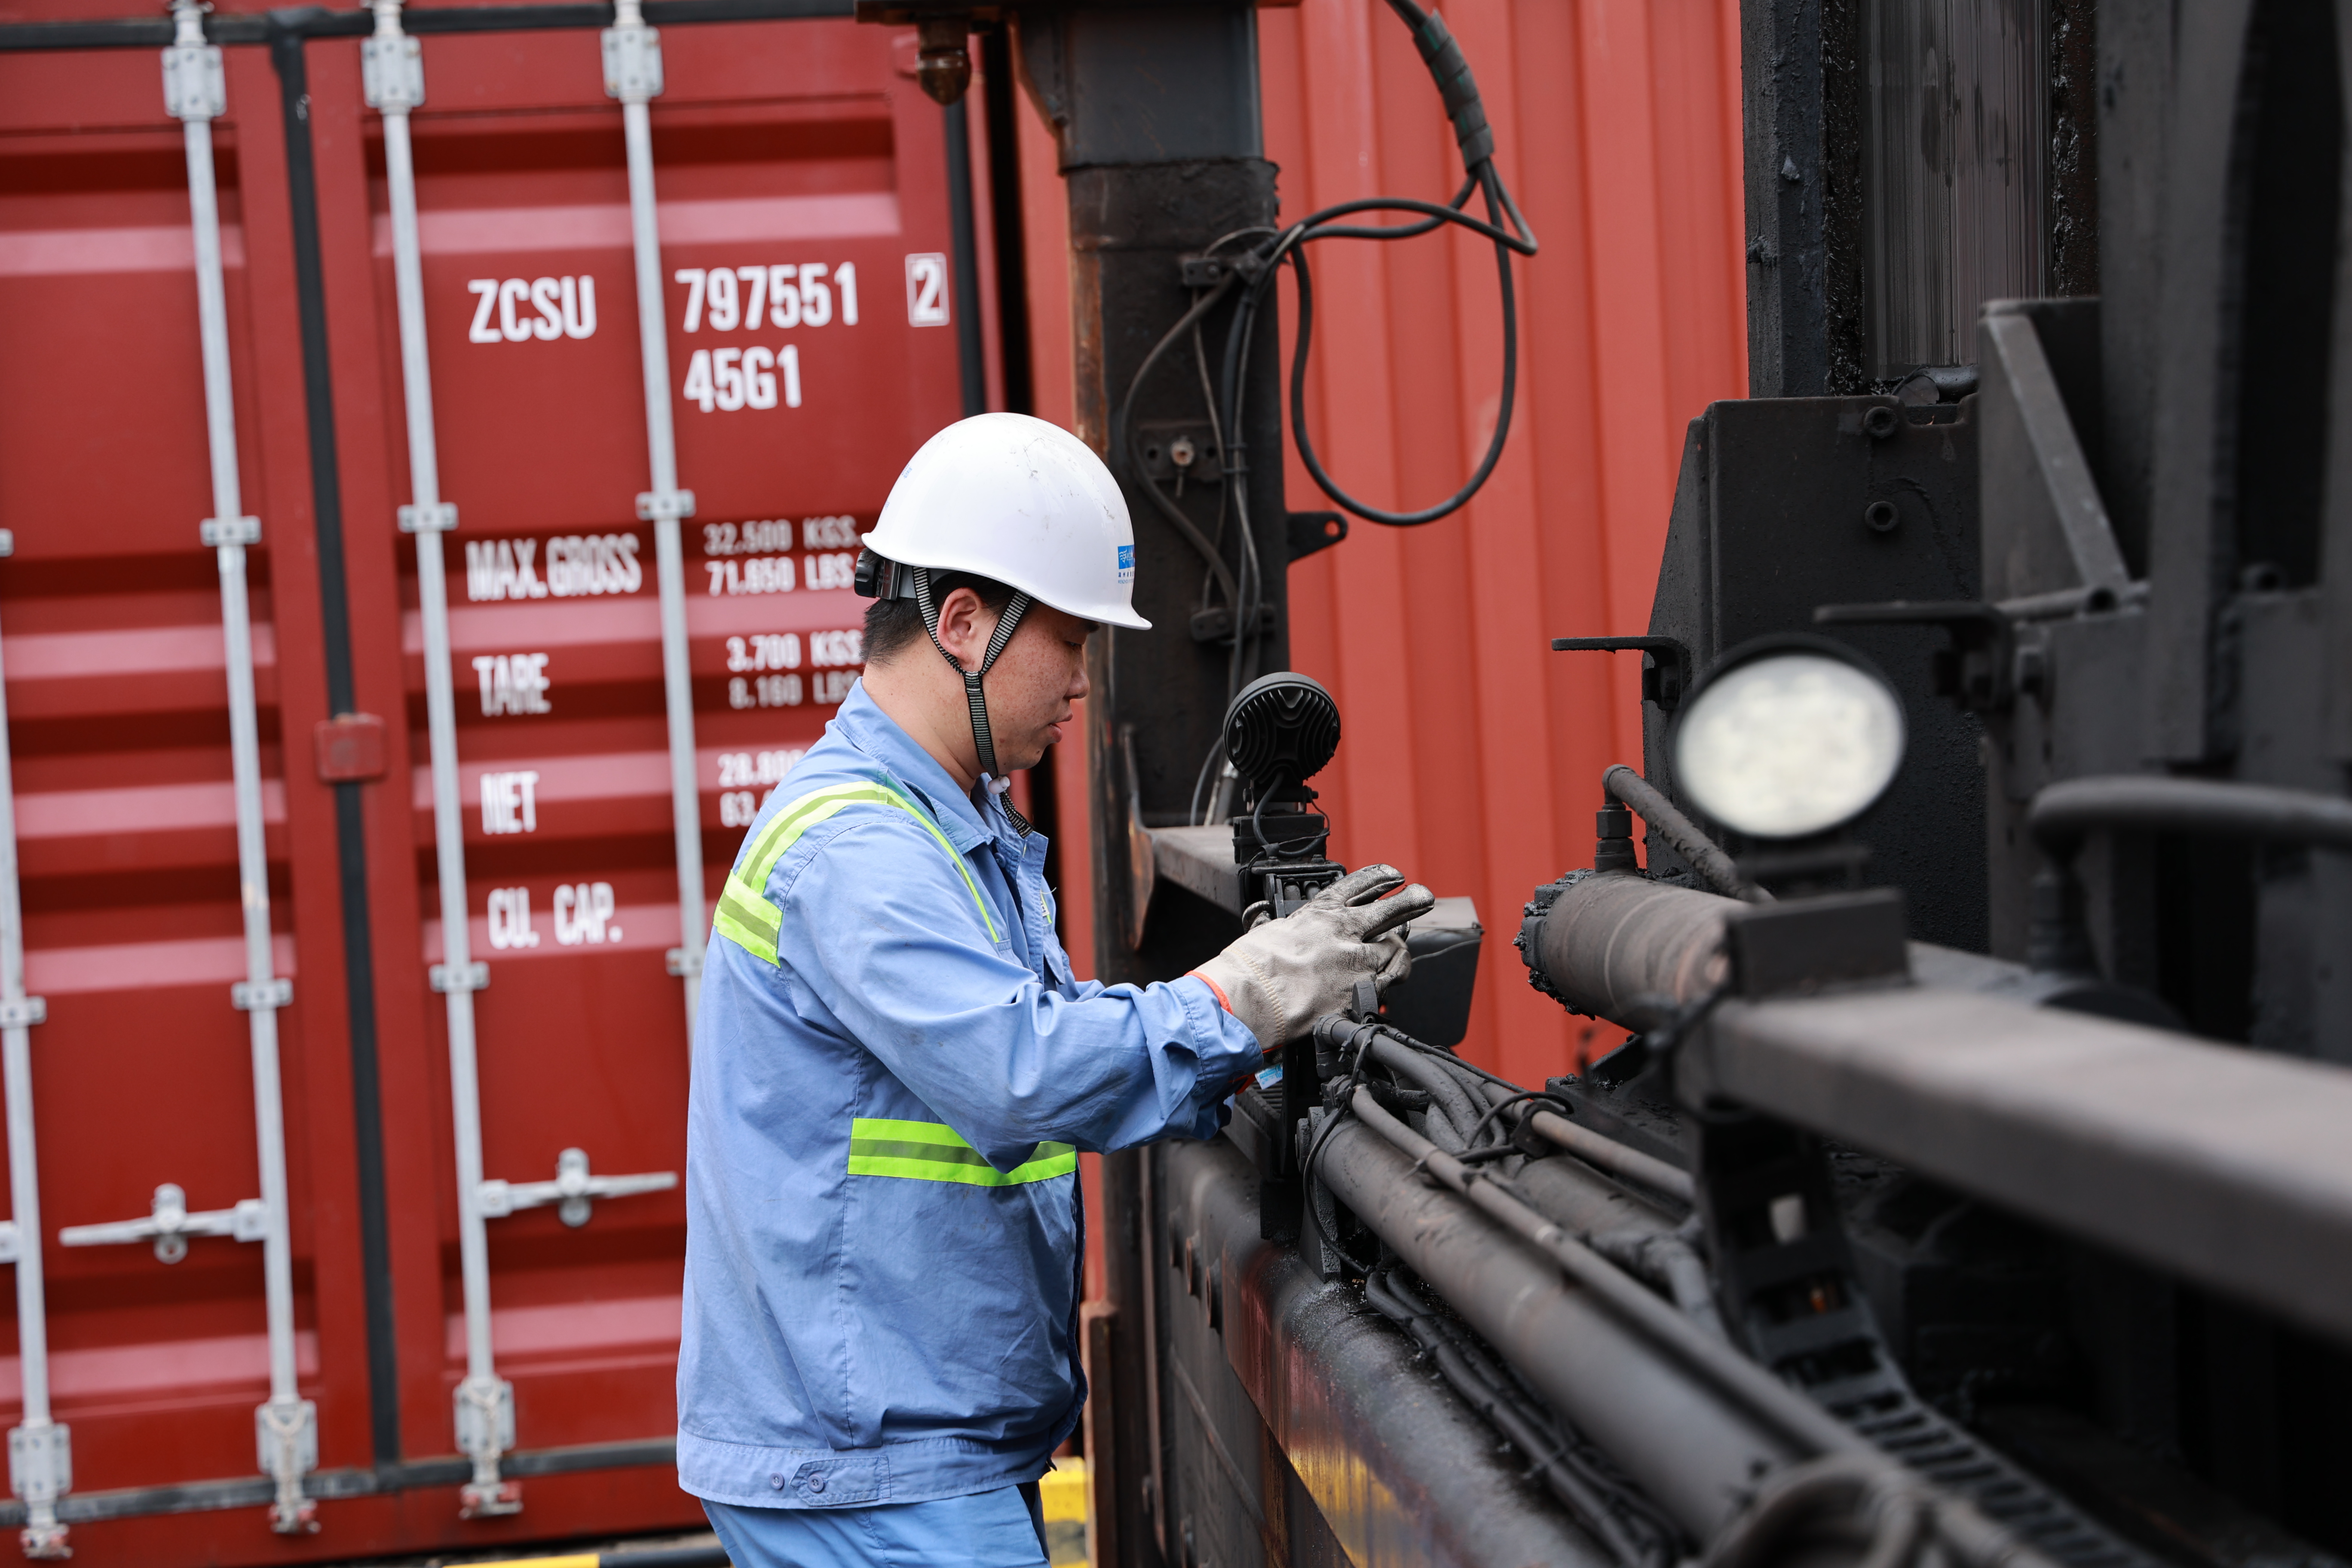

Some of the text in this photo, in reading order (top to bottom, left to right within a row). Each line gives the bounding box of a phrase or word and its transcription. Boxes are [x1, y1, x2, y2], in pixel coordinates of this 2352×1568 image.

[467, 258, 945, 343] ZCSU 797551 2
[683, 344, 802, 413] 45G1
[472, 652, 552, 717] TARE
[480, 771, 539, 835] NET
[487, 882, 623, 949] CU. CAP.
